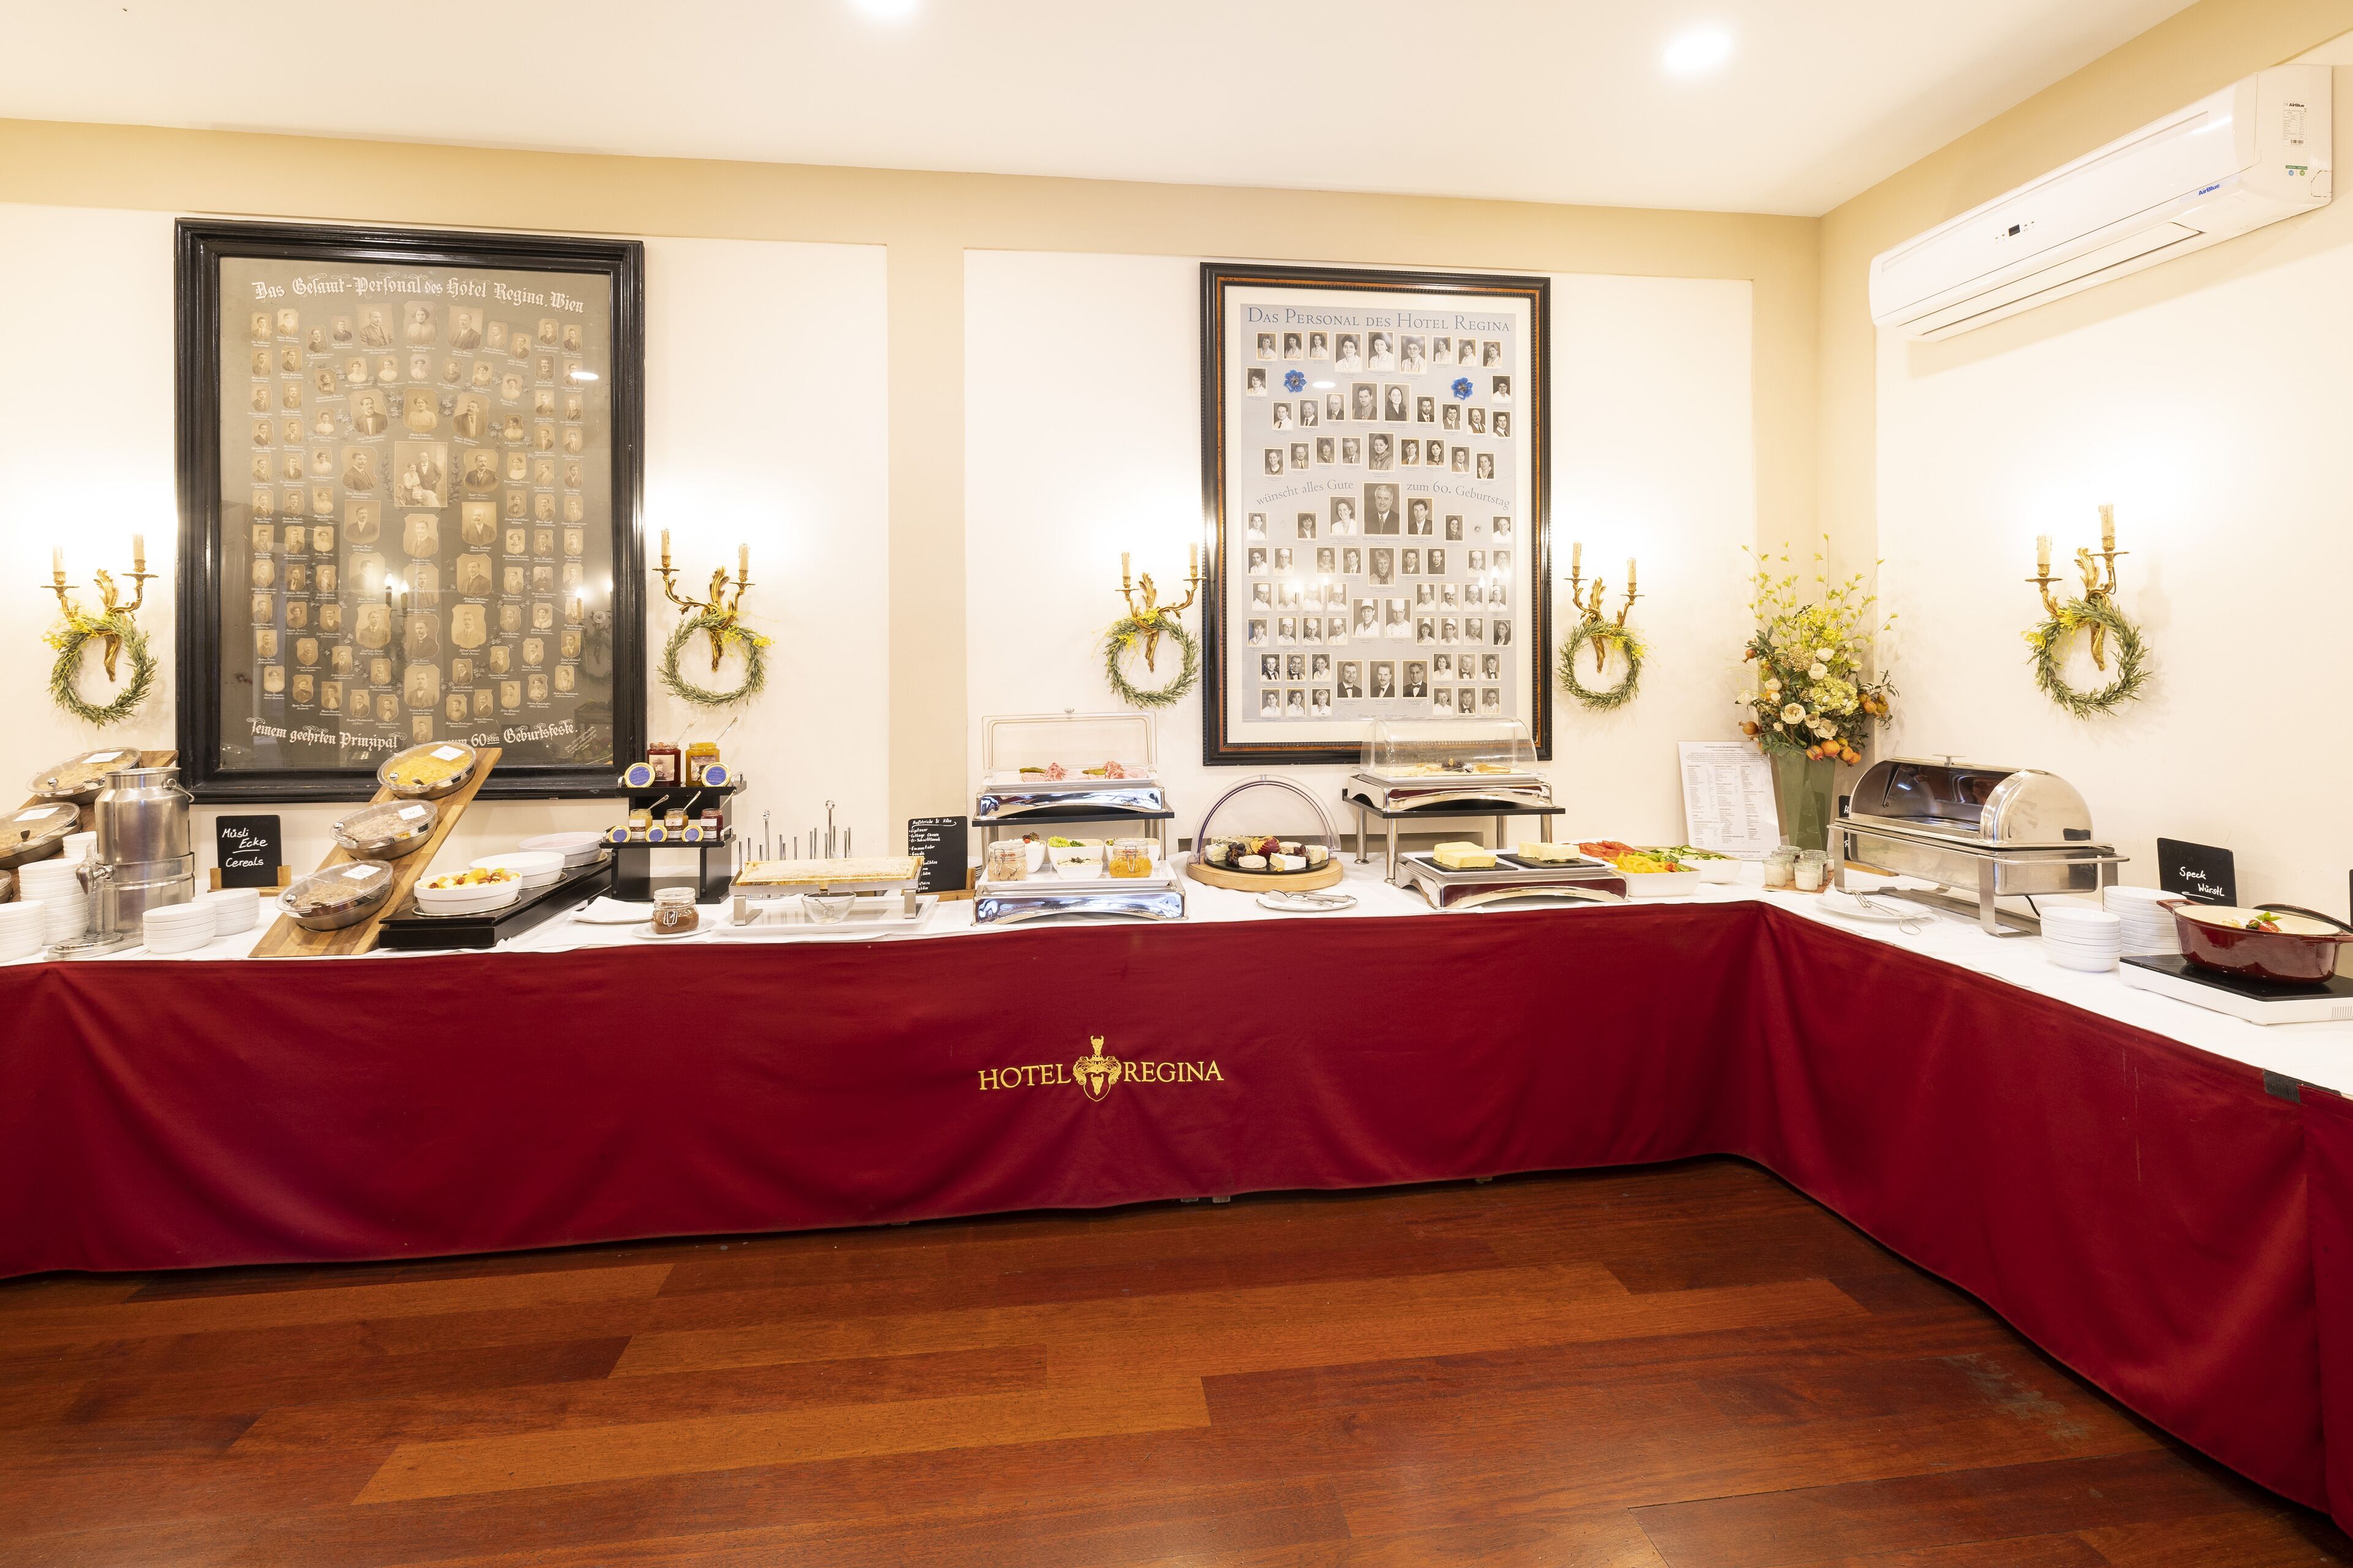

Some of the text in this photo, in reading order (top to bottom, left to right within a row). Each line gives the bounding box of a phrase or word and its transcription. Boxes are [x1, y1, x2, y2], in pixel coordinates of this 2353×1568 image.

[2199, 184, 2220, 195] AirBlue
[251, 281, 286, 301] Das
[425, 278, 444, 296] des
[550, 290, 584, 314] Wien
[1256, 486, 1299, 506] wünscht
[1302, 481, 1324, 494] alles
[1327, 479, 1354, 490] Gute
[1433, 480, 1451, 494] 60.
[1455, 485, 1510, 511] Geburtstag
[289, 725, 337, 746] geehrten
[339, 732, 404, 751] Prinzipal
[221, 827, 249, 838] Müsli
[238, 837, 268, 849] Ecke
[225, 856, 264, 868] Cereals
[2179, 866, 2207, 881] Speck
[978, 1059, 1224, 1091] HOTEL REGINA
